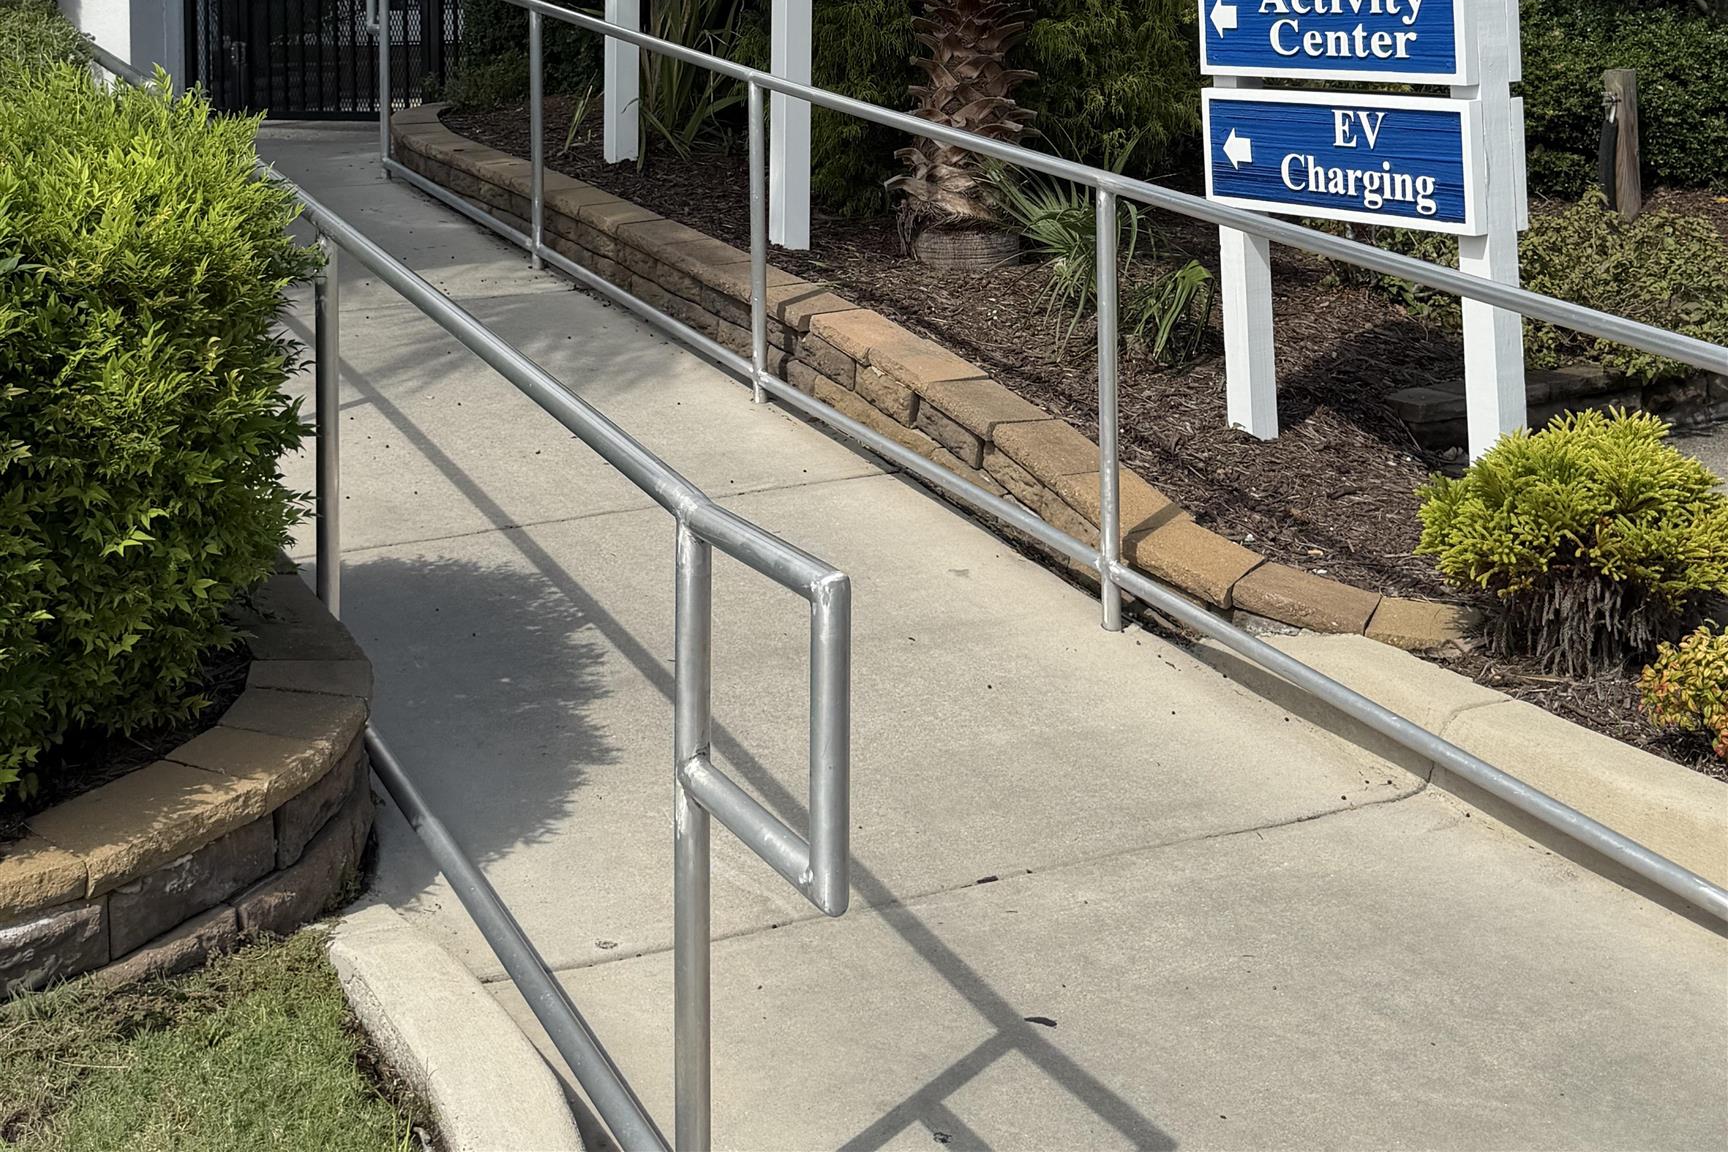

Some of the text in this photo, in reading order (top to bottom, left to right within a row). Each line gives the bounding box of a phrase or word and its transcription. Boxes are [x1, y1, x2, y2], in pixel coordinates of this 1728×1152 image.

[1269, 18, 1417, 59] Center
[1331, 109, 1387, 149] EV
[1281, 153, 1437, 214] Charging
